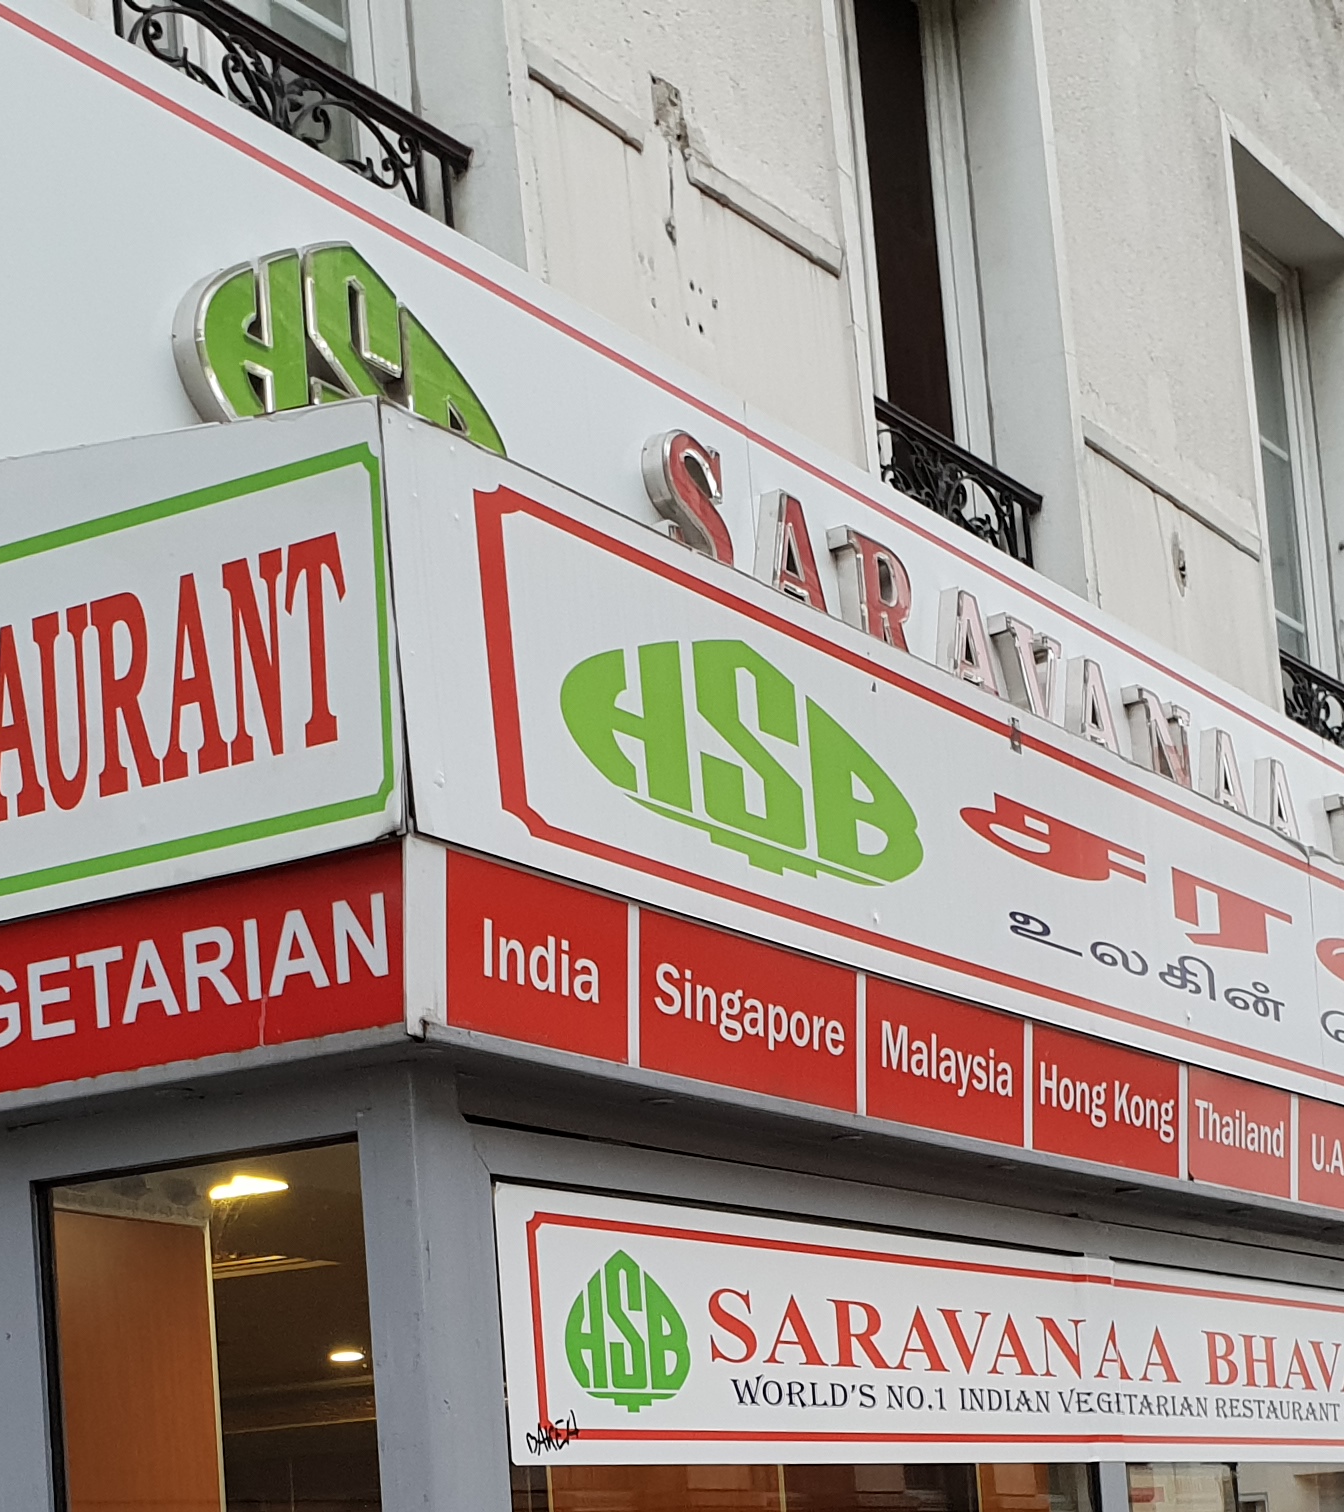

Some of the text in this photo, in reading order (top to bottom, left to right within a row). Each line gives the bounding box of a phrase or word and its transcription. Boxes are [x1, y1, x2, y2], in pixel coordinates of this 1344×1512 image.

[641, 428, 1298, 842] SARAVANAA
[560, 639, 923, 885] HSB
[482, 918, 600, 1004] India
[1009, 910, 1285, 1022] உலகின்
[654, 962, 845, 1057] Singapore
[880, 1019, 1014, 1099] Malaysia
[1039, 1060, 1176, 1143] Hong Kong
[1194, 1100, 1285, 1158] Thailand
[565, 1249, 691, 1413] HSB
[708, 1288, 1182, 1383] SARAVANAA
[731, 1374, 876, 1410] WORLD'S
[886, 1385, 947, 1411] NO.1
[960, 1387, 1052, 1413] INDIAN
[1057, 1388, 1209, 1419] VEGITARIAN
[1215, 1398, 1341, 1423] RESTAURANT
